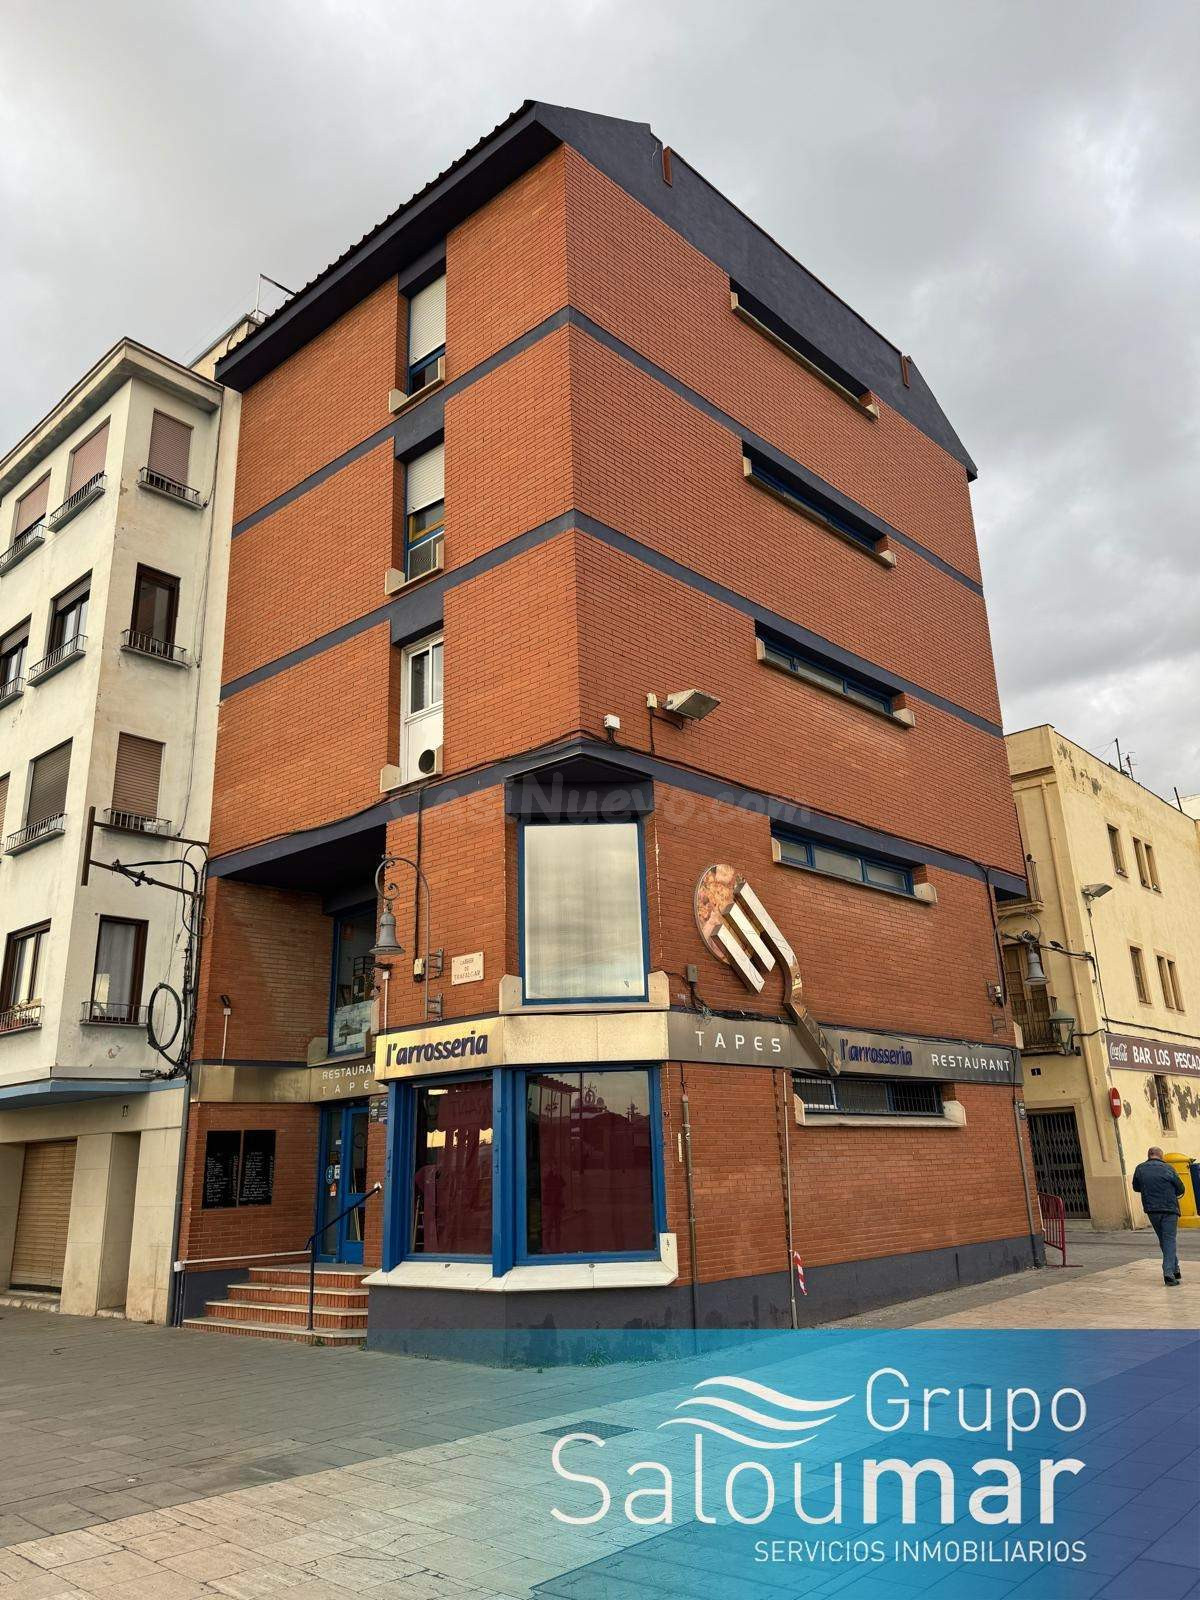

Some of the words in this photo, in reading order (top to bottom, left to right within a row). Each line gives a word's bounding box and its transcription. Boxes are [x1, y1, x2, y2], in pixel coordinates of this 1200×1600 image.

[386, 1030, 488, 1067] l'arrosseria
[695, 1030, 782, 1053] TAPES
[839, 1038, 913, 1066] l'arrosseria
[931, 1053, 1011, 1072] RESTAURANT
[1132, 1045, 1153, 1065] BAR
[1154, 1048, 1171, 1067] LOS
